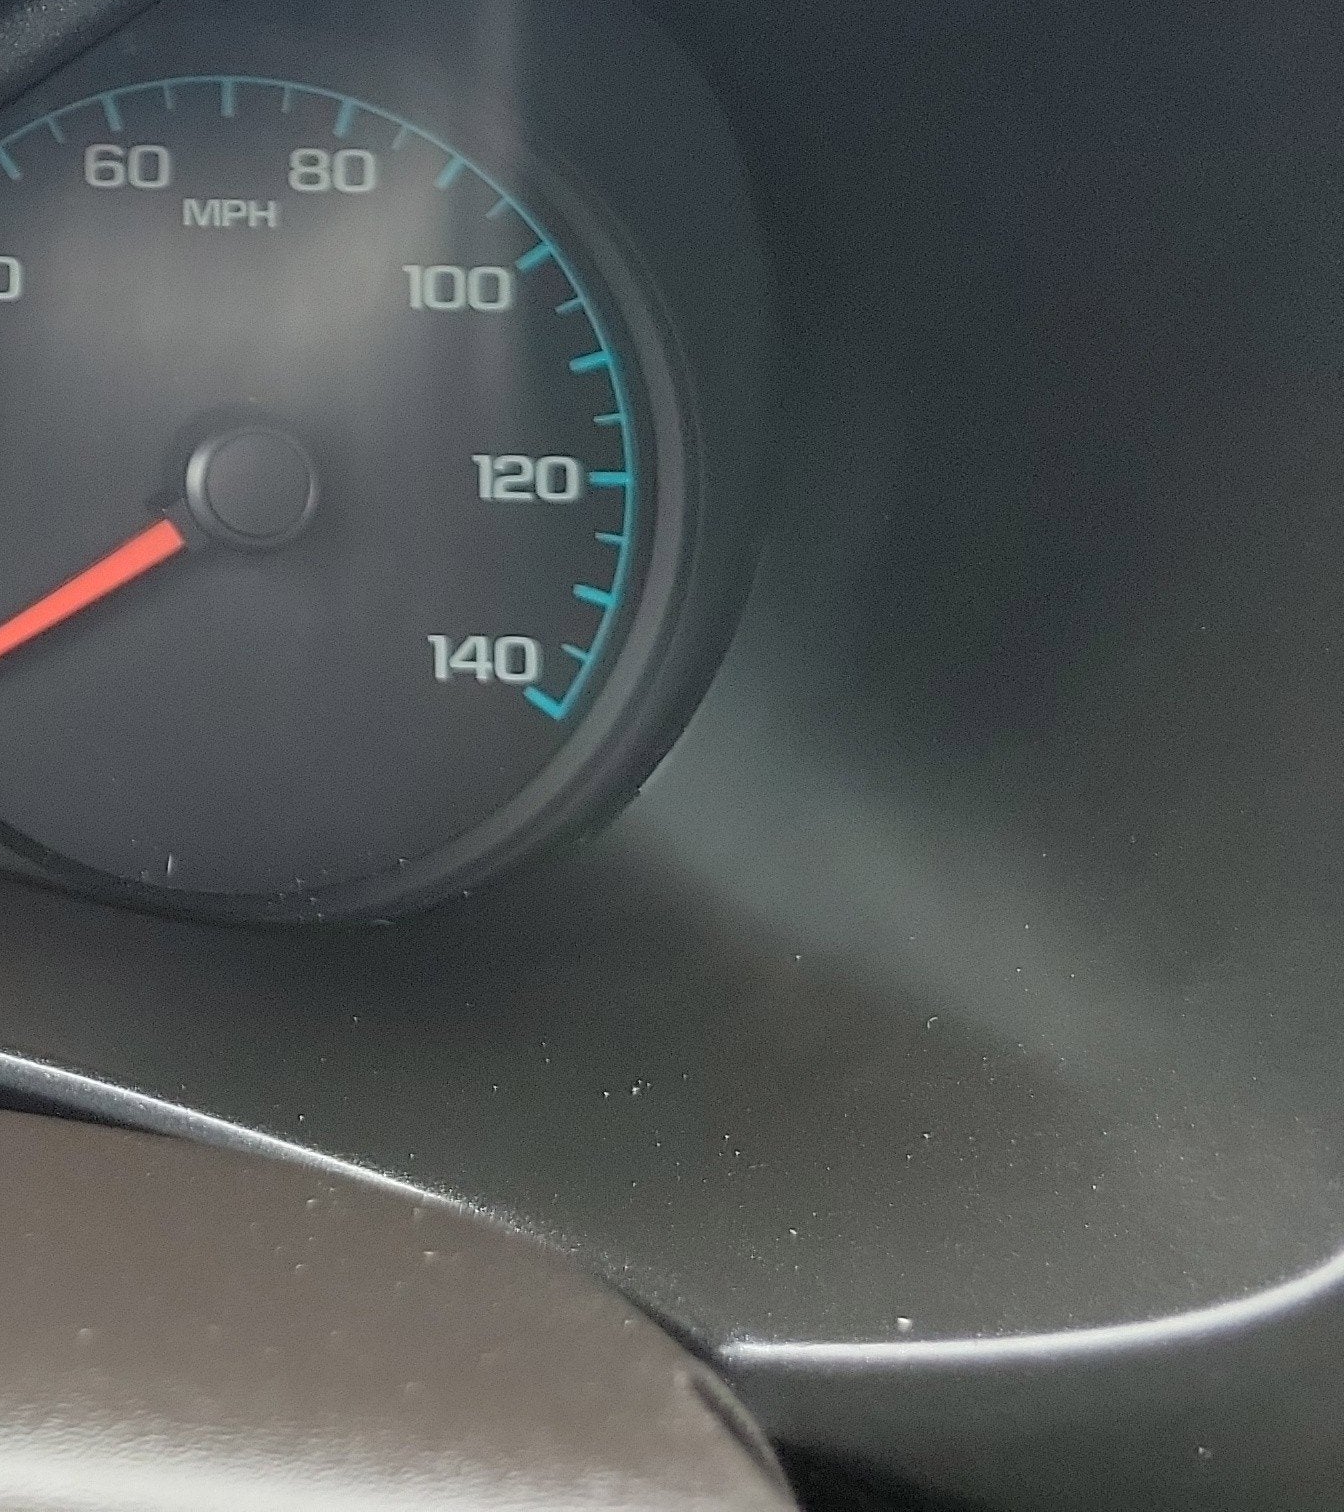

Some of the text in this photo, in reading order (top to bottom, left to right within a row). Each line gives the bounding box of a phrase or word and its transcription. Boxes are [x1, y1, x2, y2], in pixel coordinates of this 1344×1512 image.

[83, 143, 173, 191] 60
[287, 147, 380, 196] 80
[181, 197, 280, 230] MPH
[401, 263, 513, 312] 100
[471, 453, 582, 503] 120
[426, 634, 540, 685] 140
